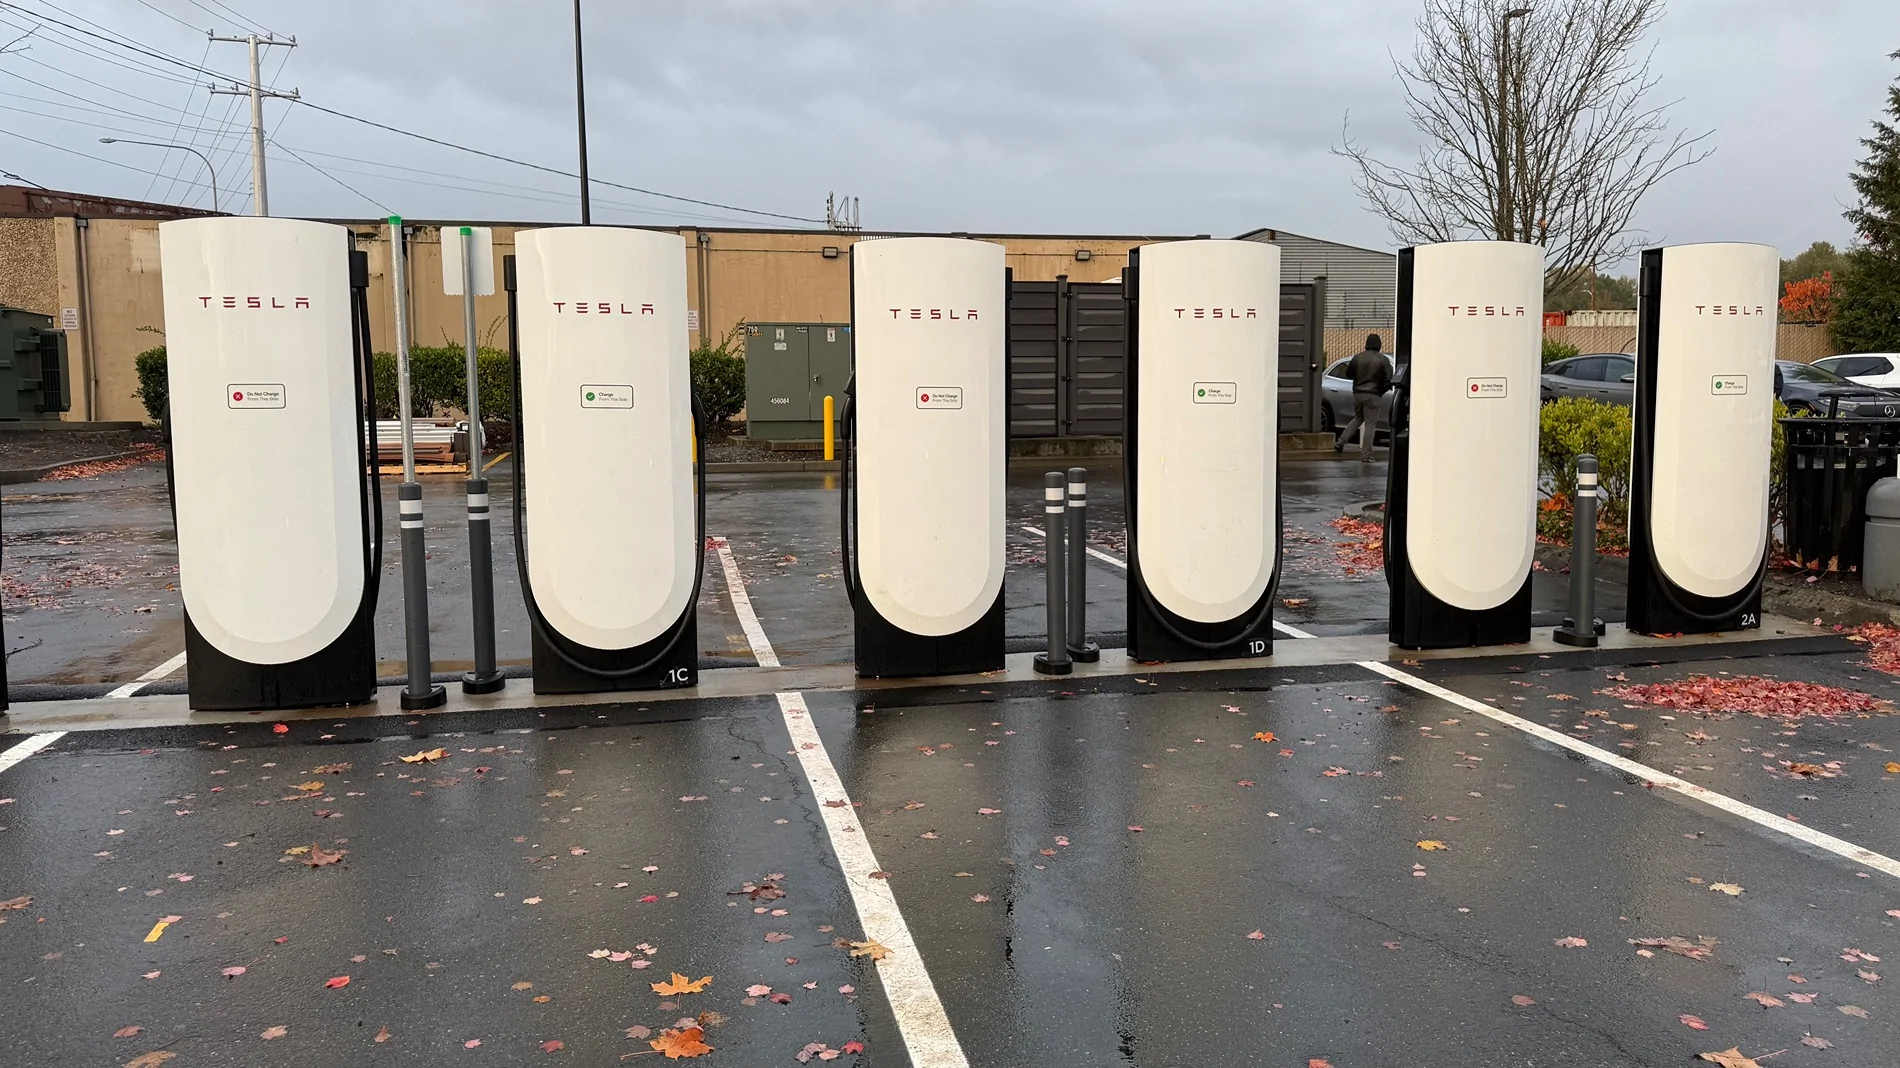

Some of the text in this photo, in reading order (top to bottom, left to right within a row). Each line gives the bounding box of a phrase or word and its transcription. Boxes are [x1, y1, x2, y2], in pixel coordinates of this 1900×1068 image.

[199, 296, 310, 309] TESLA
[553, 302, 654, 315] TESLA
[890, 308, 978, 320] TESLA
[1174, 308, 1256, 319] TESLA
[1448, 306, 1525, 316] TESLA
[1695, 305, 1763, 316] TESLA
[1741, 613, 1756, 626] 2A
[1249, 640, 1265, 654] 1D
[669, 667, 689, 683] 1C
